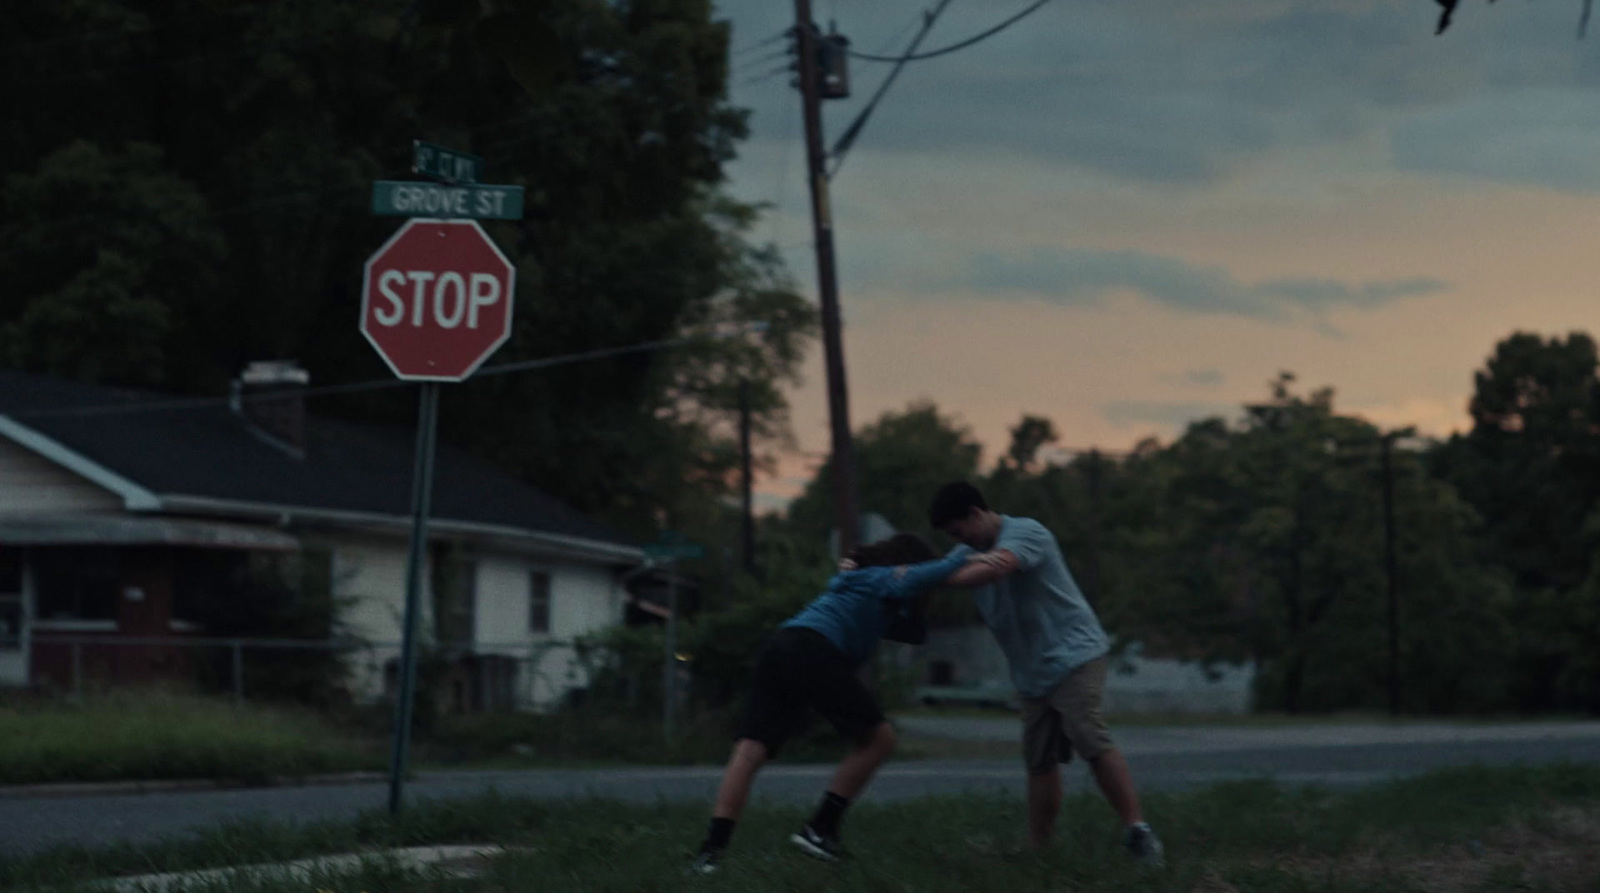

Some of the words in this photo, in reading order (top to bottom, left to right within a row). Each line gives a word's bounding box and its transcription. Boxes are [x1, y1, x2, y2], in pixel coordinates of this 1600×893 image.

[391, 185, 470, 214] GROVE
[475, 189, 507, 216] ST
[374, 269, 501, 329] STOP
